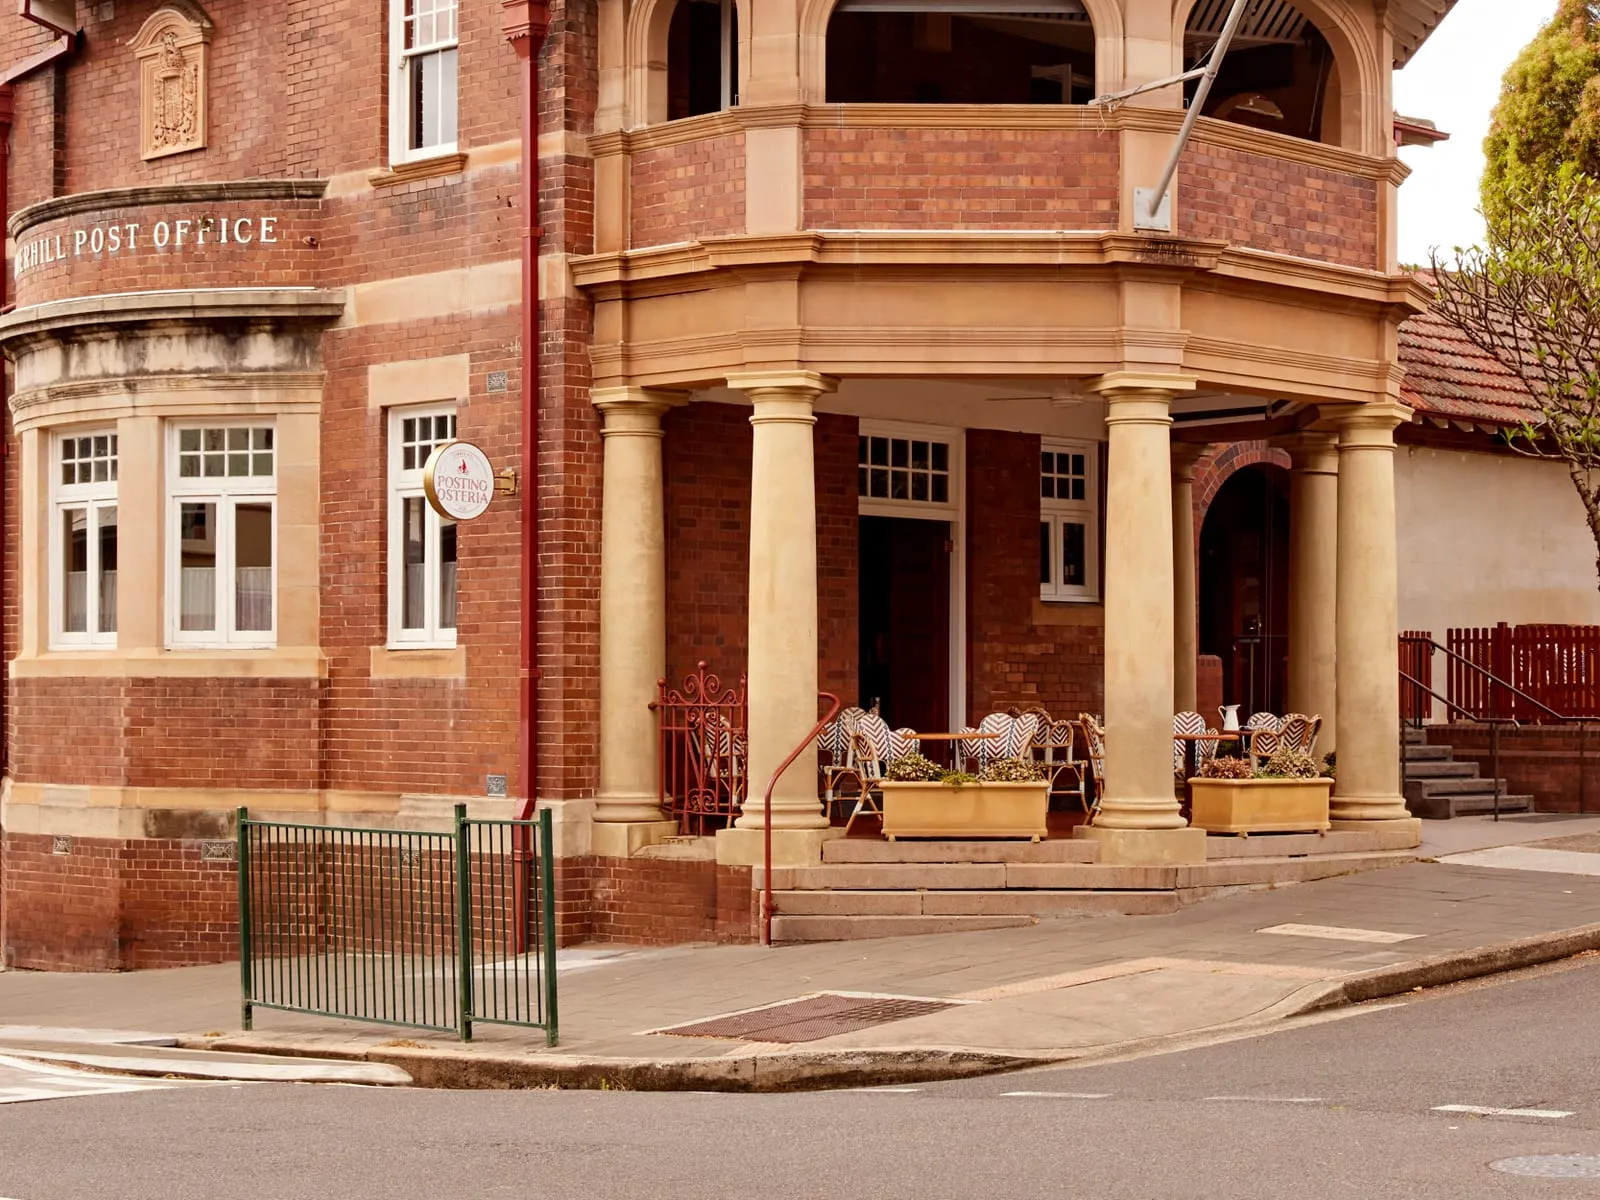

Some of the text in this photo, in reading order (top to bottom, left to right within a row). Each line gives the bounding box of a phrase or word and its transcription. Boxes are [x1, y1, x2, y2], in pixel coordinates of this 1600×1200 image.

[75, 224, 139, 255] POST
[153, 217, 278, 247] OFFICE
[437, 475, 488, 492] POSTING
[437, 488, 489, 504] OSTERIA
